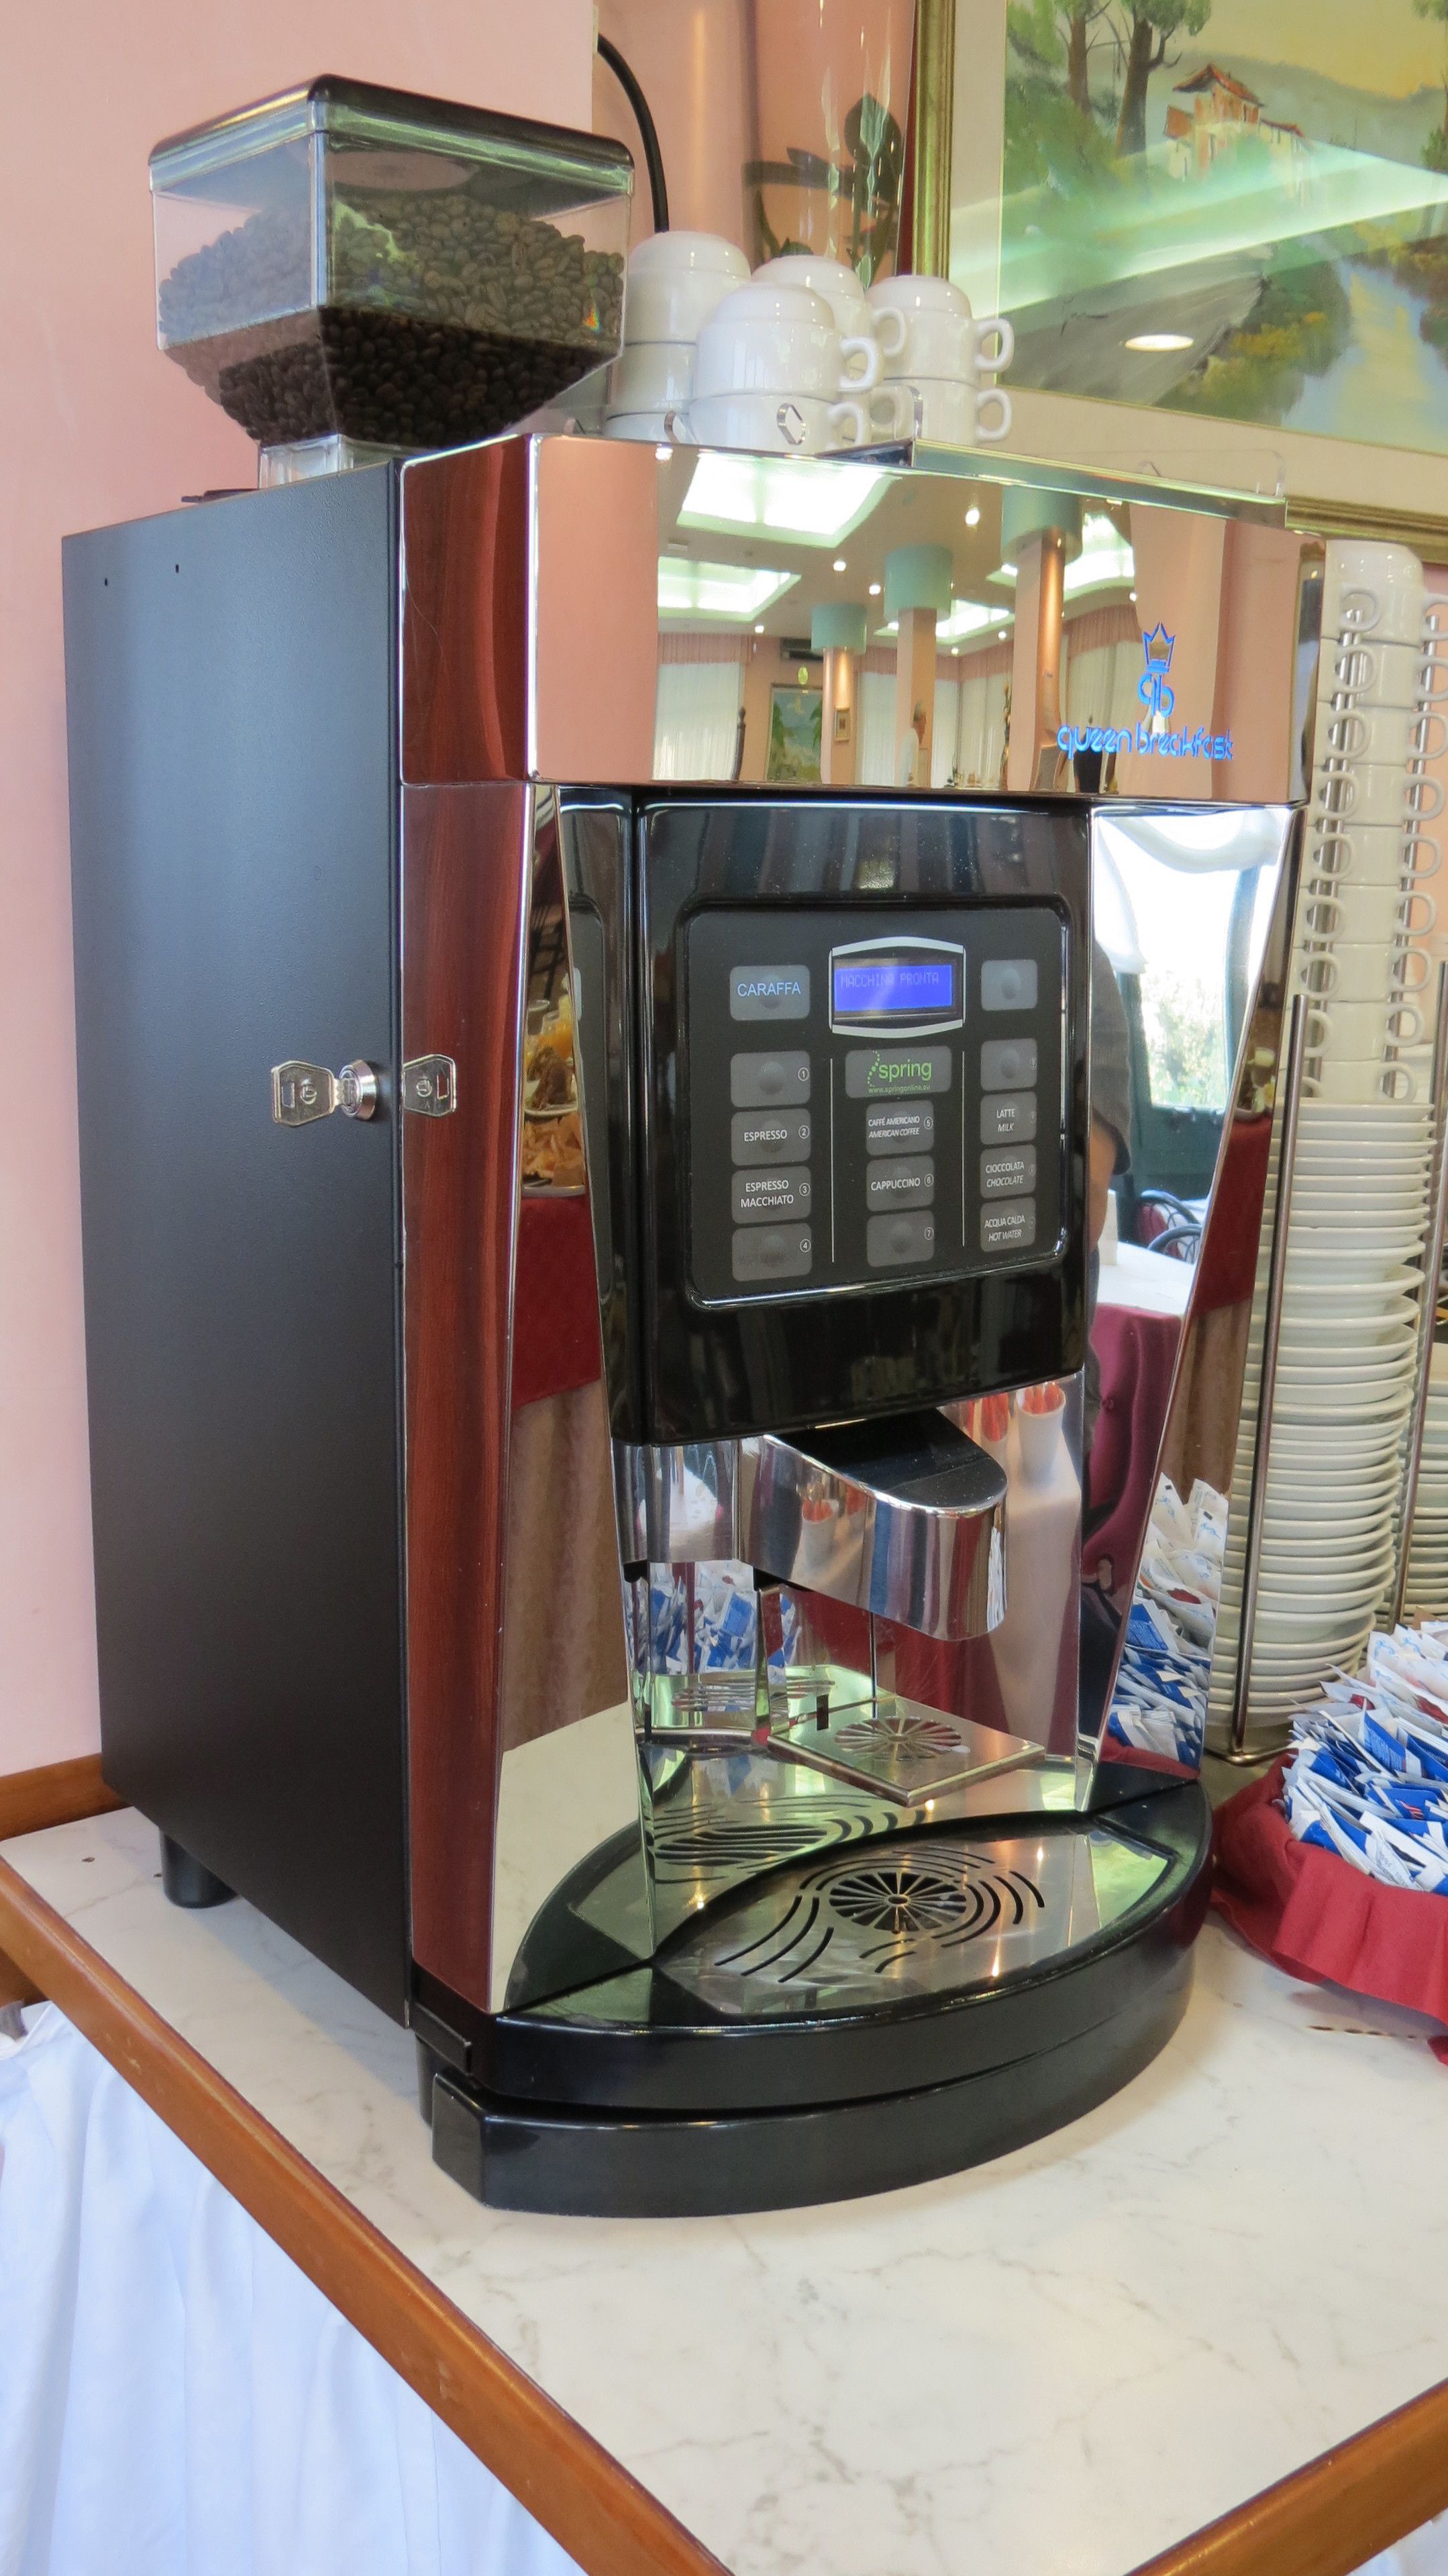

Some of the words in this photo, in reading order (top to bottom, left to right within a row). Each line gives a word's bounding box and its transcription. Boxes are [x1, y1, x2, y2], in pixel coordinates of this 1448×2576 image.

[1057, 723, 1133, 761] queen
[1135, 722, 1234, 761] breakfast
[900, 972, 939, 986] PRONTA
[737, 981, 801, 997] CARAFFA
[878, 1059, 932, 1083] spring
[868, 1084, 931, 1094] www.springonline.eu
[996, 1108, 1016, 1119] LATTE
[886, 1116, 920, 1126] AMERICANO
[998, 1122, 1015, 1132] MILK
[743, 1129, 788, 1142] ESPRESSO
[868, 1129, 900, 1138] AMERICAN
[900, 1127, 920, 1136] COFFEE
[985, 1161, 1025, 1174] CIOCCOLATA
[745, 1179, 789, 1193] ESPRESSO
[870, 1177, 921, 1191] CAPPUCCINO
[986, 1175, 1024, 1187] CHOCOLATE
[740, 1194, 794, 1208] MACCHIATO
[984, 1218, 1006, 1228] ACQUA
[1006, 1215, 1026, 1226] CALDA
[988, 1232, 1002, 1242] HOT
[1002, 1229, 1022, 1240] WATER
